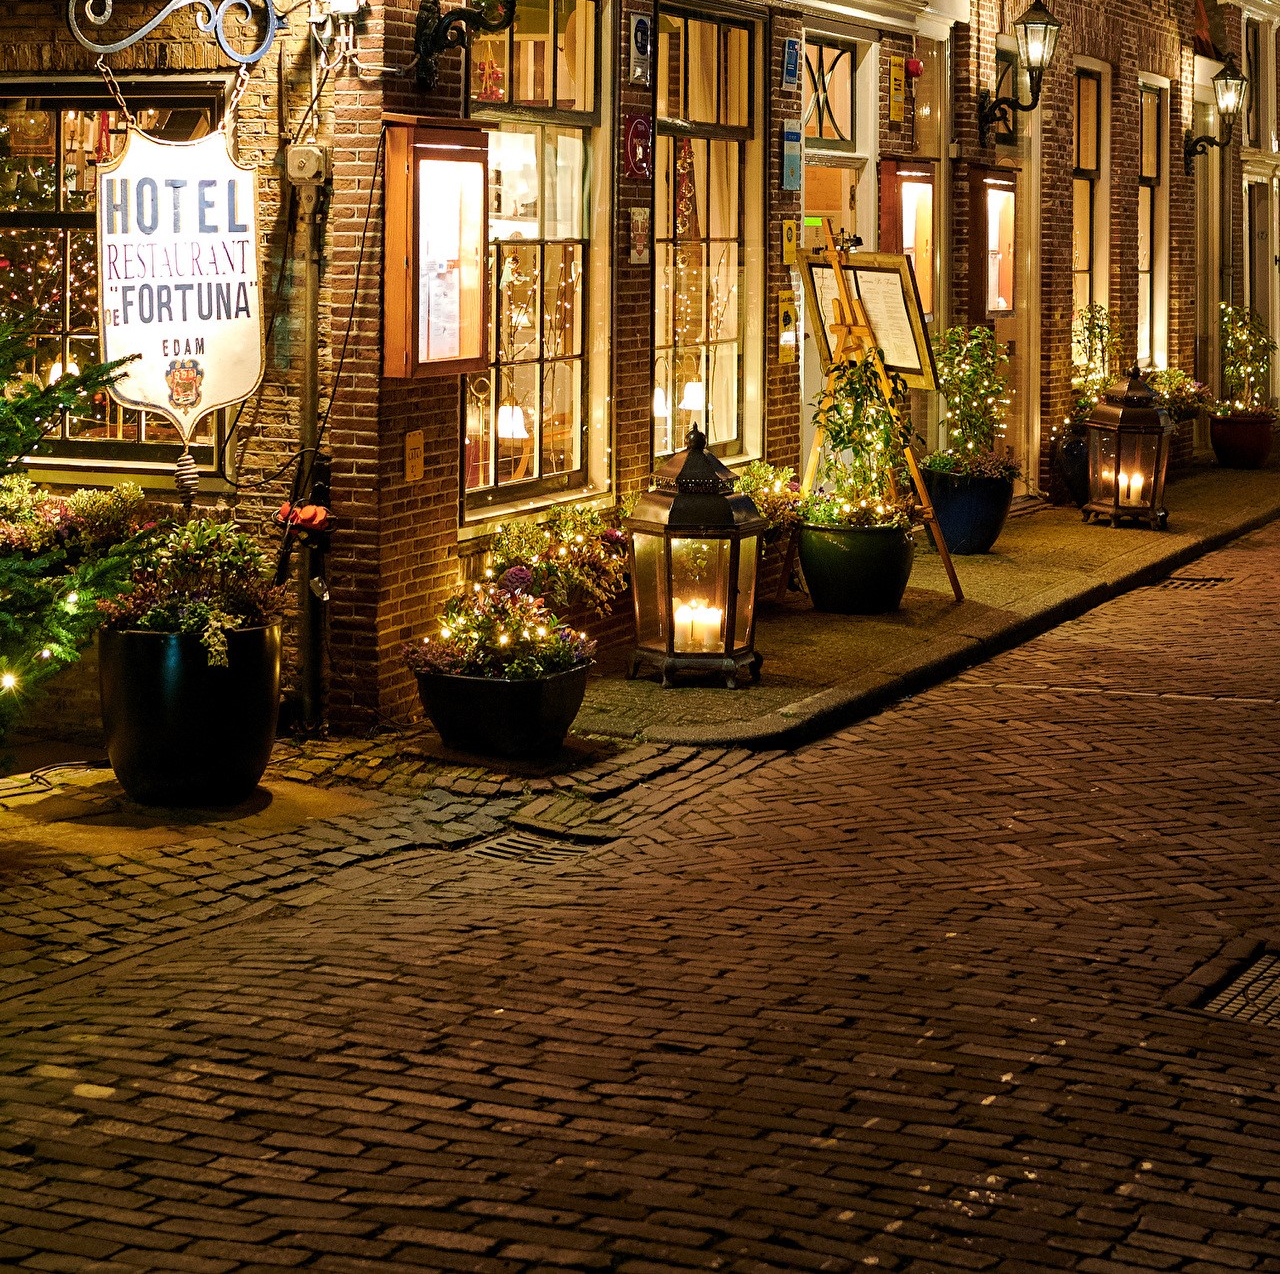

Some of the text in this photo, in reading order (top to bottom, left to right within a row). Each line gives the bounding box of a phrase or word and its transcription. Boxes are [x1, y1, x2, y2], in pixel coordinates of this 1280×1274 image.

[106, 177, 249, 235] HOTEL
[107, 239, 250, 280] RESTAURANT
[104, 308, 120, 327] DE
[162, 337, 205, 357] EDAM
